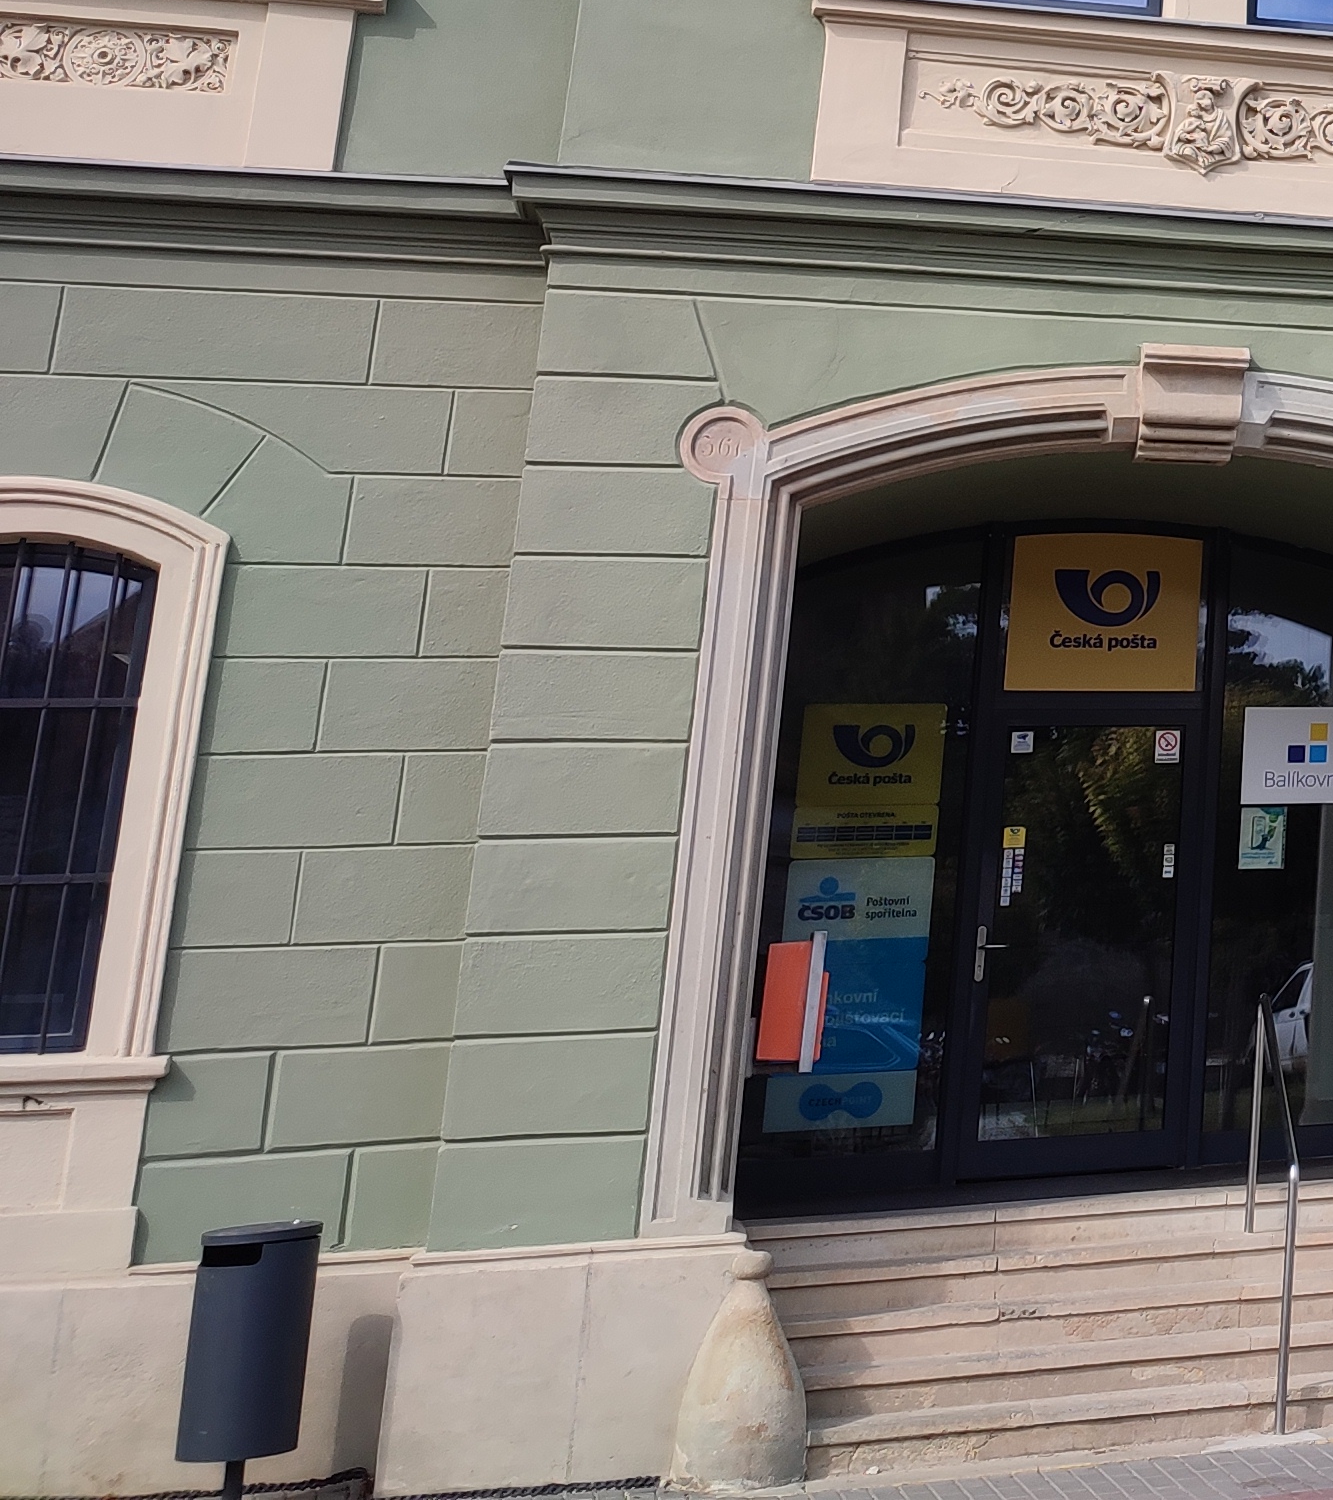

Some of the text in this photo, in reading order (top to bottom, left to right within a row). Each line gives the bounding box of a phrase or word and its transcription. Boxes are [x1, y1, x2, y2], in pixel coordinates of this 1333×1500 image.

[1049, 630, 1157, 652] Česká pošta
[827, 771, 912, 786] Česká pošta
[798, 895, 910, 921] ČSOB Poštovní
[865, 907, 917, 921] spořitelna
